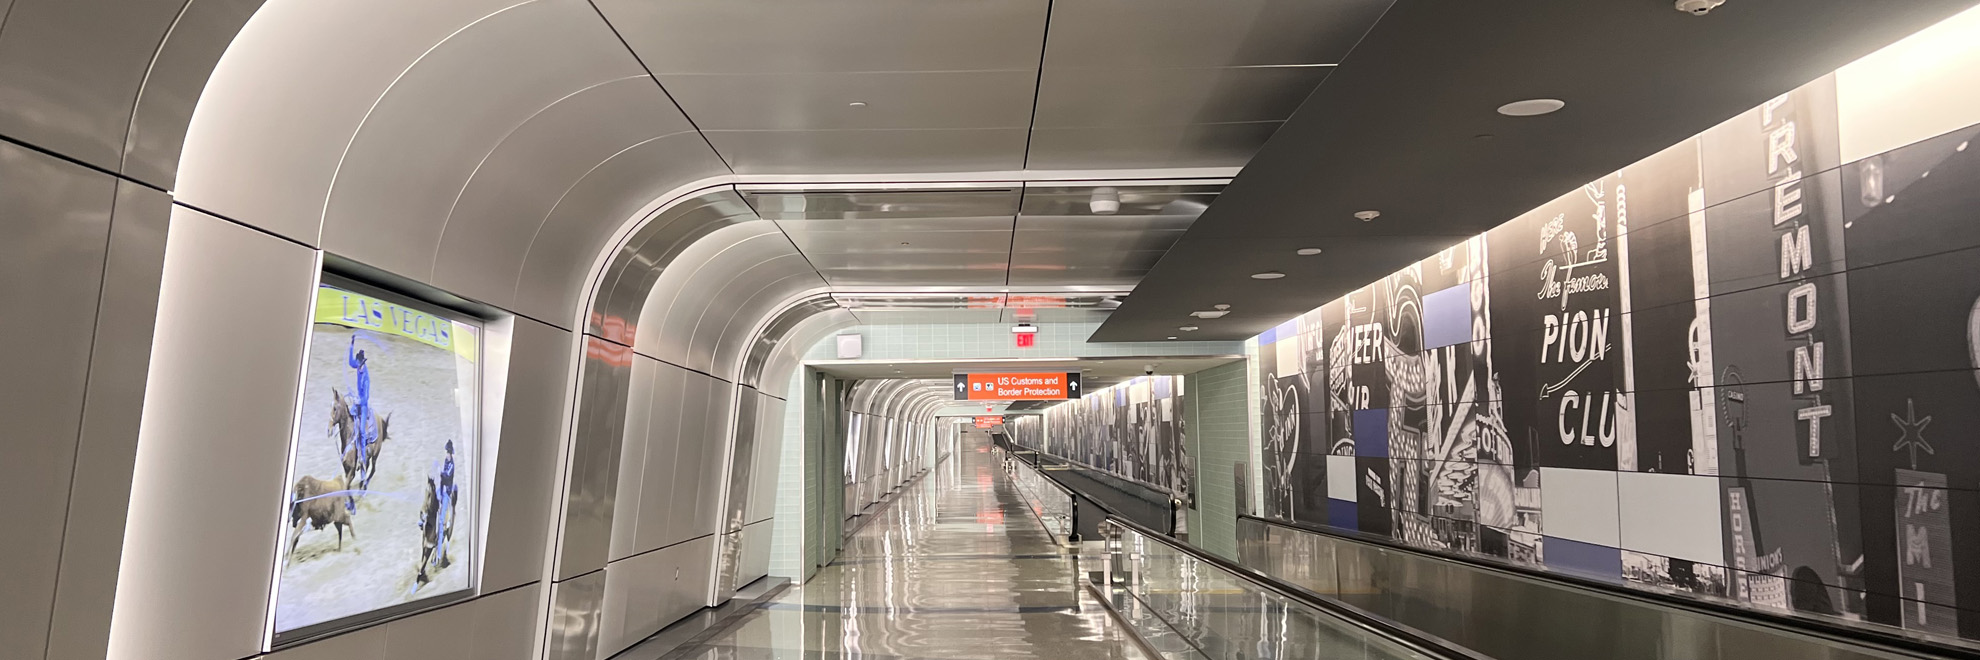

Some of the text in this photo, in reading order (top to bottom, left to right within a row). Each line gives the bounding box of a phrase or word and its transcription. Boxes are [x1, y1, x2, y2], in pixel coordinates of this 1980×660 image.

[341, 295, 449, 345] LAS VEGAS
[1541, 308, 1610, 364] PION
[1016, 333, 1034, 347] EXIT
[997, 376, 1059, 386] US Customs and
[997, 387, 1061, 396] Border Protection
[1558, 389, 1616, 448] CLU
